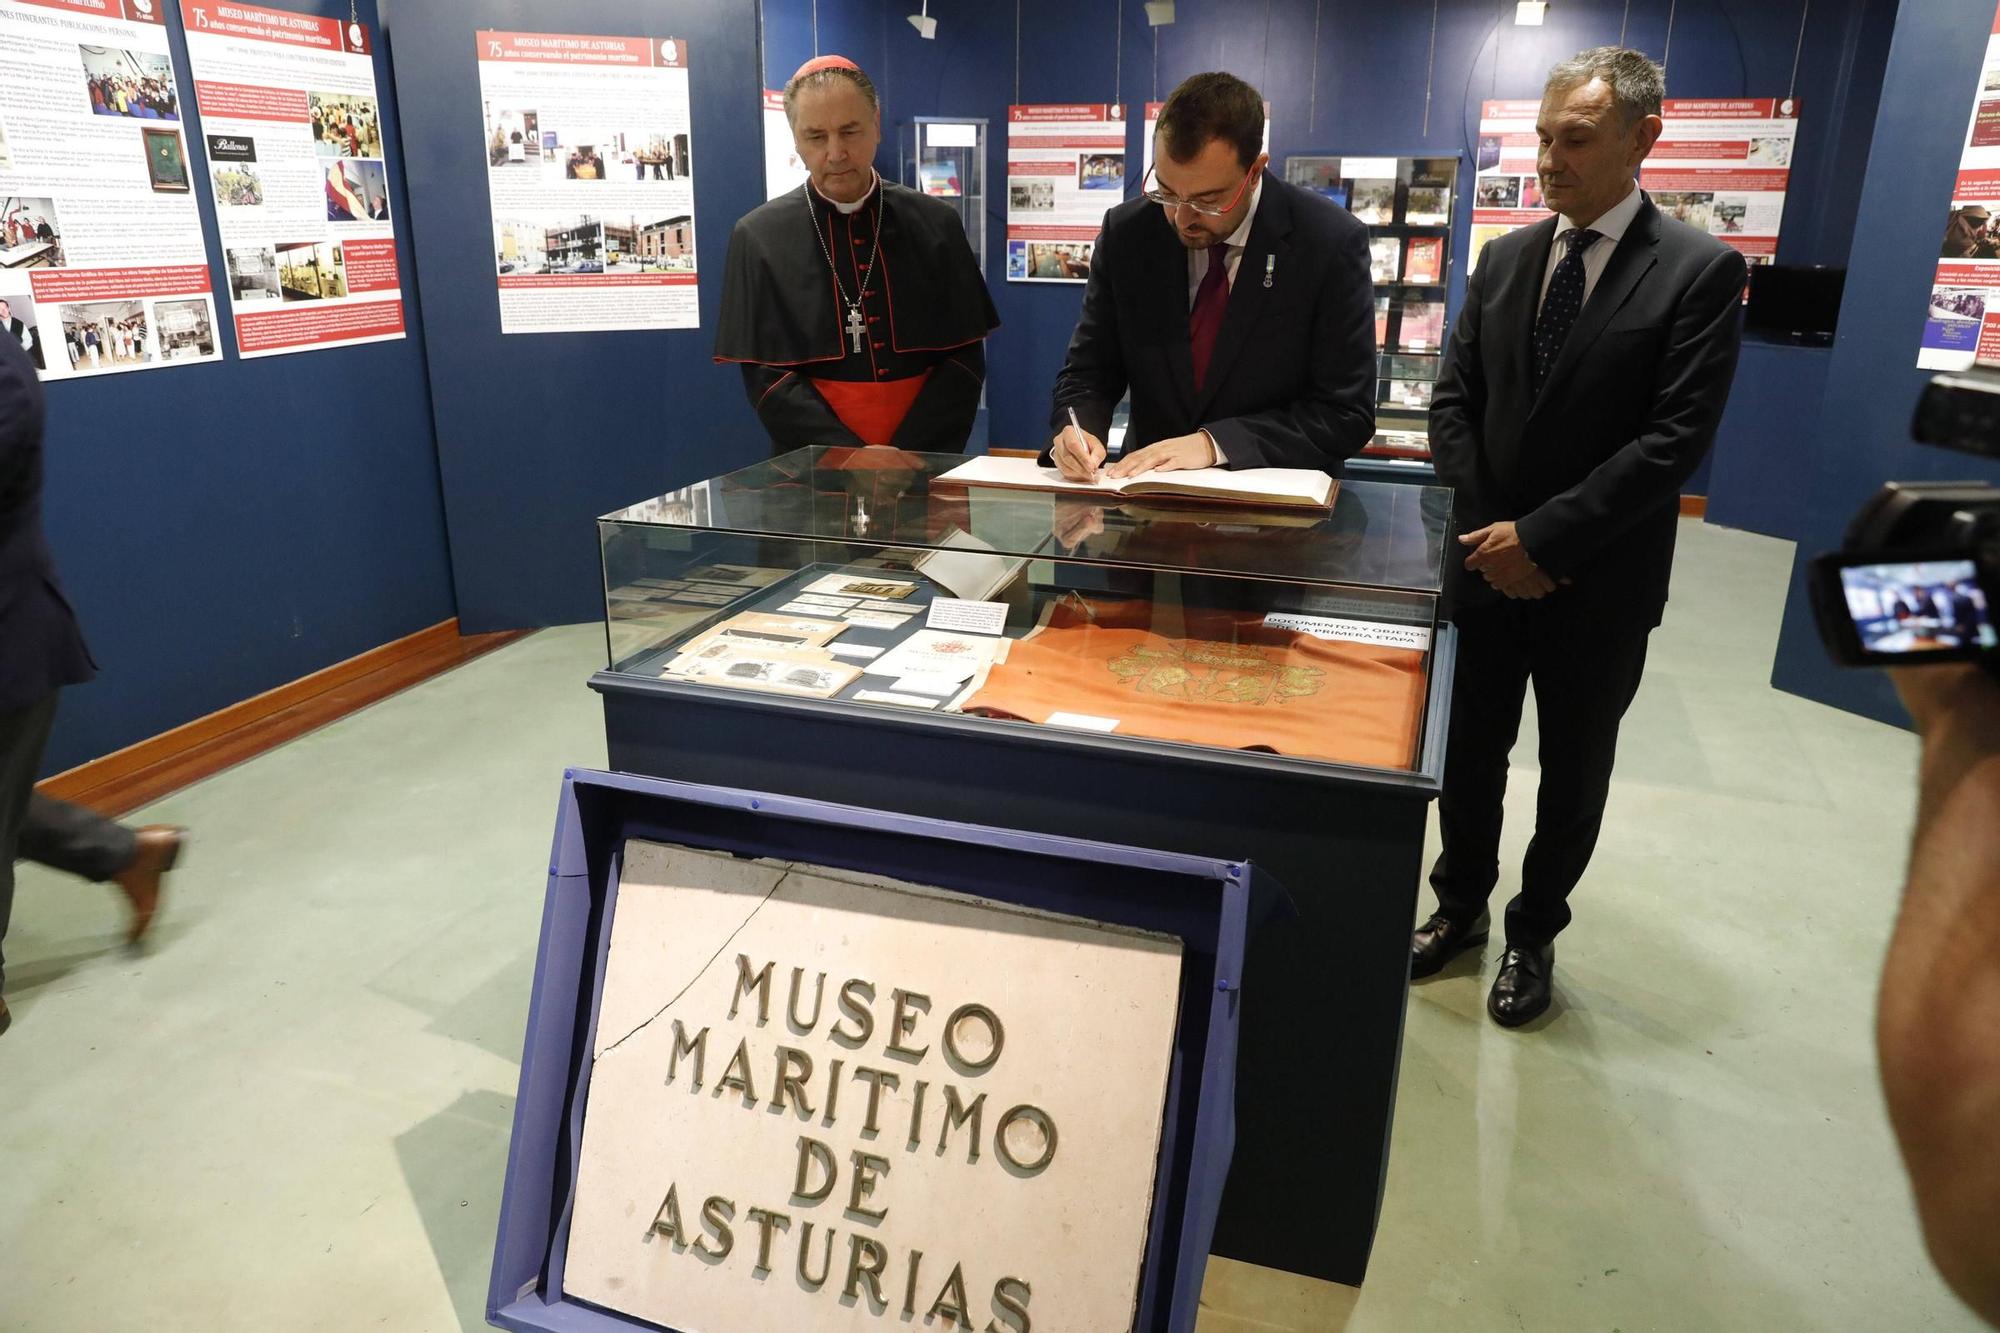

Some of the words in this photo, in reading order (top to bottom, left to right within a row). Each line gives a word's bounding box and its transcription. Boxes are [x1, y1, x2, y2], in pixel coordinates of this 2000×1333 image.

[192, 7, 209, 28] 75
[209, 20, 226, 30] años
[226, 23, 265, 36] conservando
[271, 29, 305, 42] patrimonio
[217, 6, 243, 20] MUSEO
[280, 15, 289, 26] DE
[289, 17, 320, 32] ASTURIAS
[488, 40, 503, 58] 75
[521, 50, 562, 59] conservando
[570, 53, 607, 62] patrimonio
[513, 37, 539, 47] MUSEO
[580, 40, 591, 49] DE
[591, 40, 625, 51] ASTURIAS
[1268, 617, 1358, 632] DOCUMENTOS
[1373, 628, 1428, 638] OBJETOS
[1314, 628, 1373, 639] PRIMERA
[1376, 635, 1416, 644] ETAPA
[727, 953, 1005, 1073] MUSEO
[664, 1019, 1058, 1174] MARITIMO
[789, 1135, 891, 1224] DE
[643, 1182, 1032, 1333] ASTURIAS
